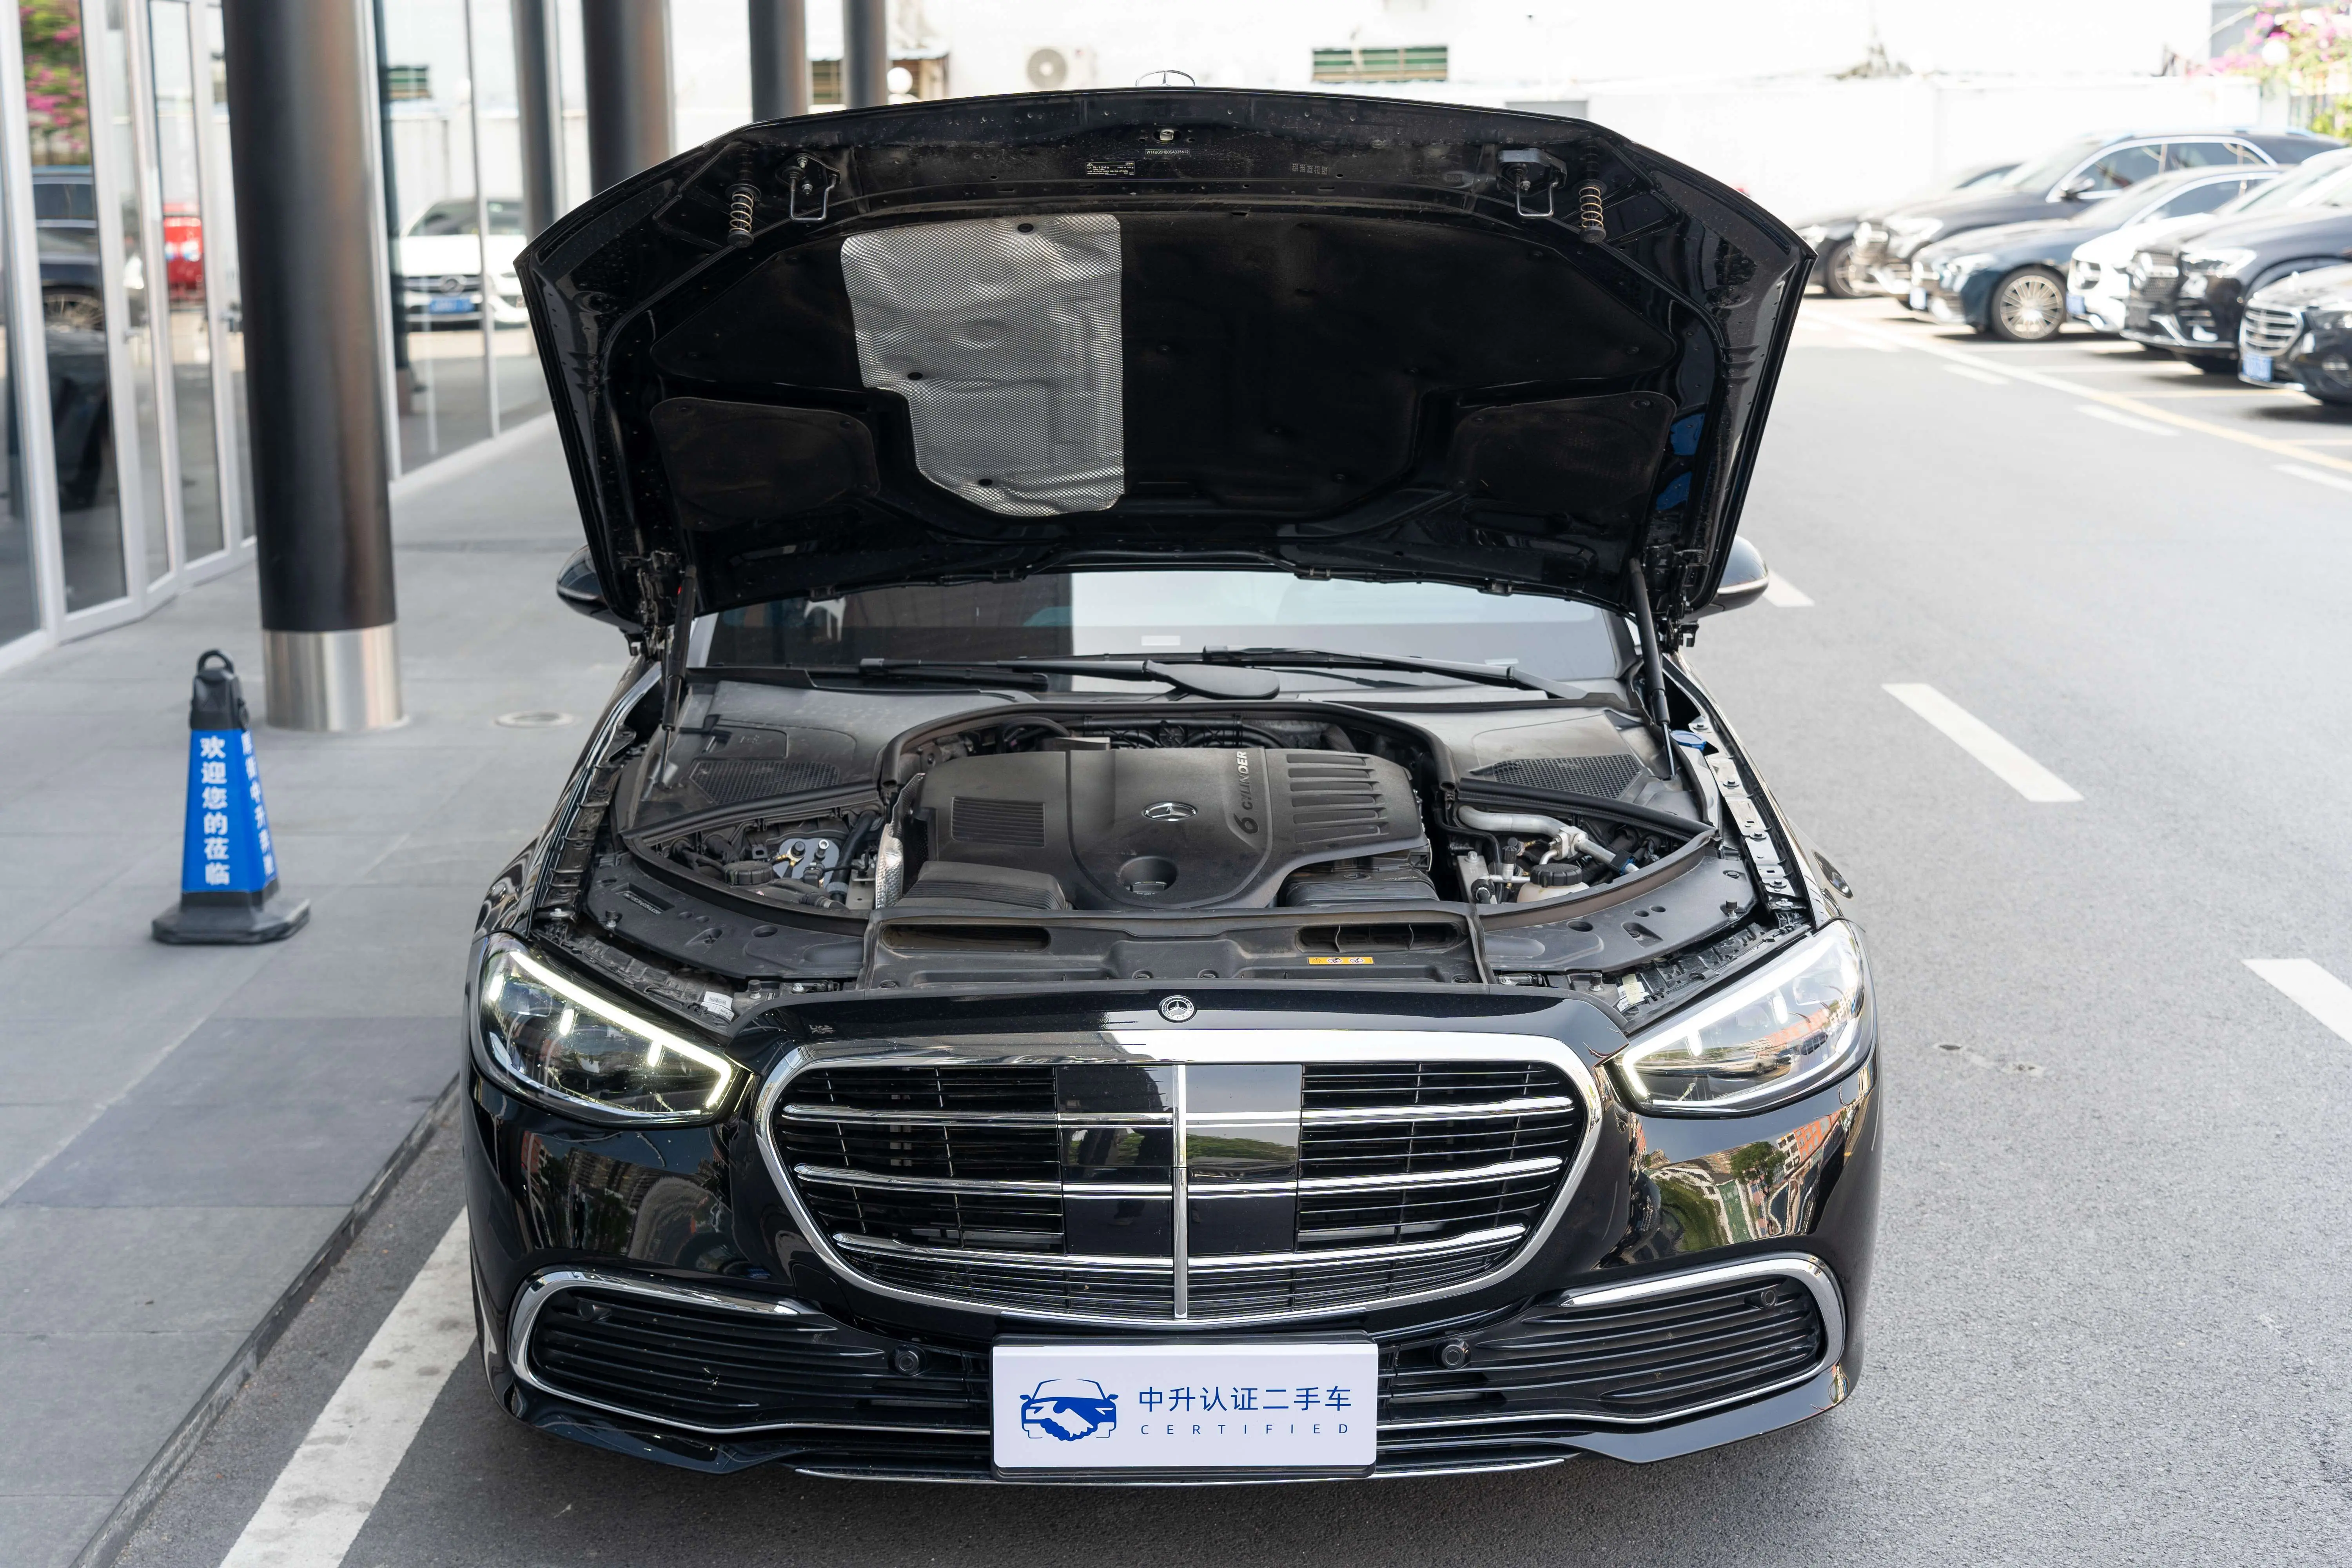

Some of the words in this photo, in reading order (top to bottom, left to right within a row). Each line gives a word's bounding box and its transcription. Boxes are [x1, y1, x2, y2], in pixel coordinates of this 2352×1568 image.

[1236, 751, 1253, 810] CYLINDER
[200, 736, 230, 886] 欢迎您的莅临
[1234, 813, 1259, 834] 6
[1138, 1386, 1352, 1412] 中升认证二手车
[1141, 1424, 1348, 1435] CERTIFIED
